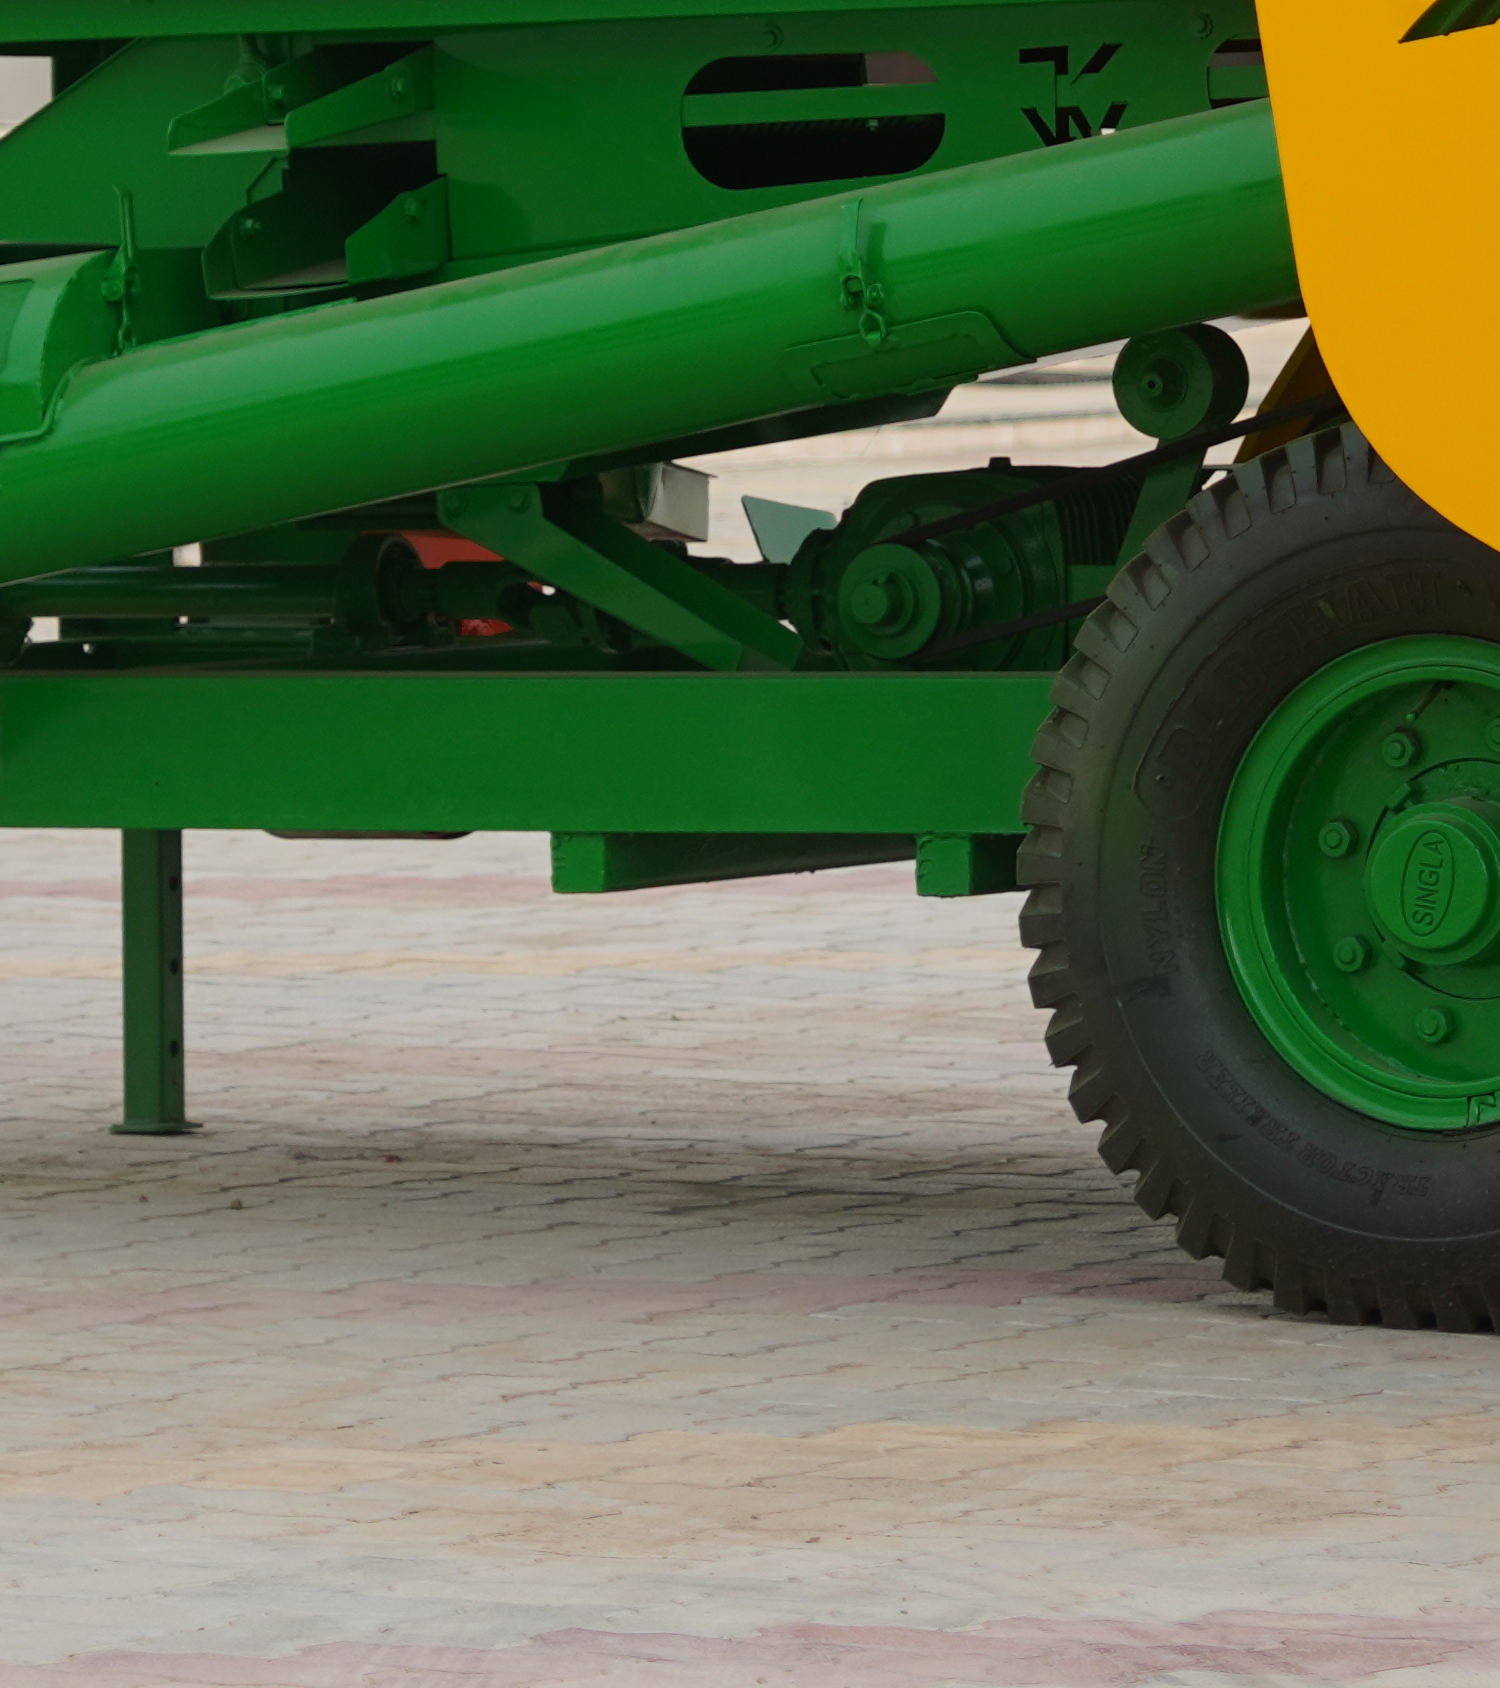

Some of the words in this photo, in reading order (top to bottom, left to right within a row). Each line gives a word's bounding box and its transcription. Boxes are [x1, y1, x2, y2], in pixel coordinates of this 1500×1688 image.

[1138, 842, 1180, 975] NYLON
[1412, 839, 1445, 926] SINGLA
[1296, 1141, 1432, 1197] TRACTOR
